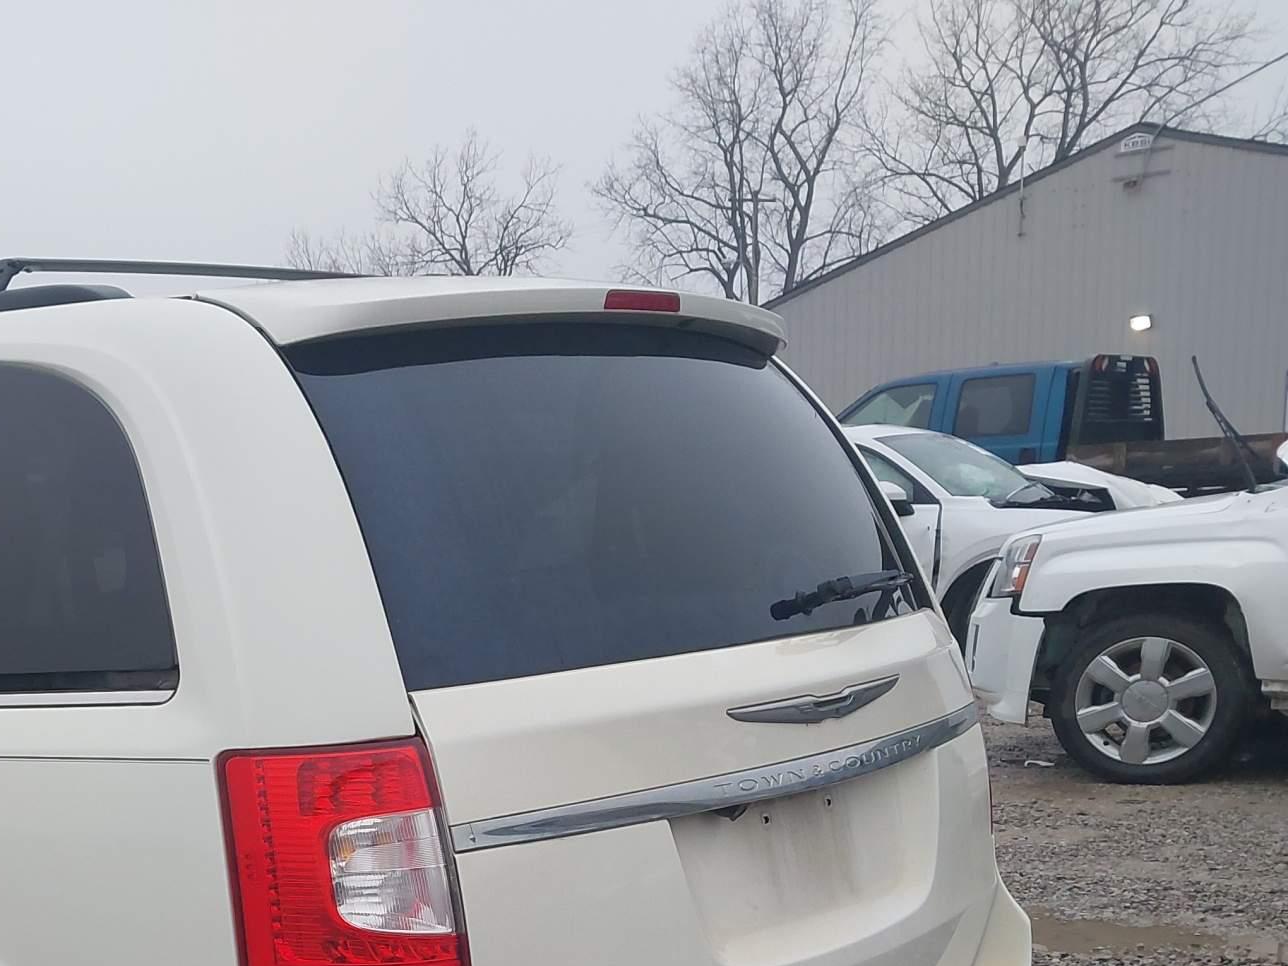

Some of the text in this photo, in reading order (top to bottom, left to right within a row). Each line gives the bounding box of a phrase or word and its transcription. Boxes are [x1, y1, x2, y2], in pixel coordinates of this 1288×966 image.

[714, 734, 922, 797] TOWN & COUNTRY
